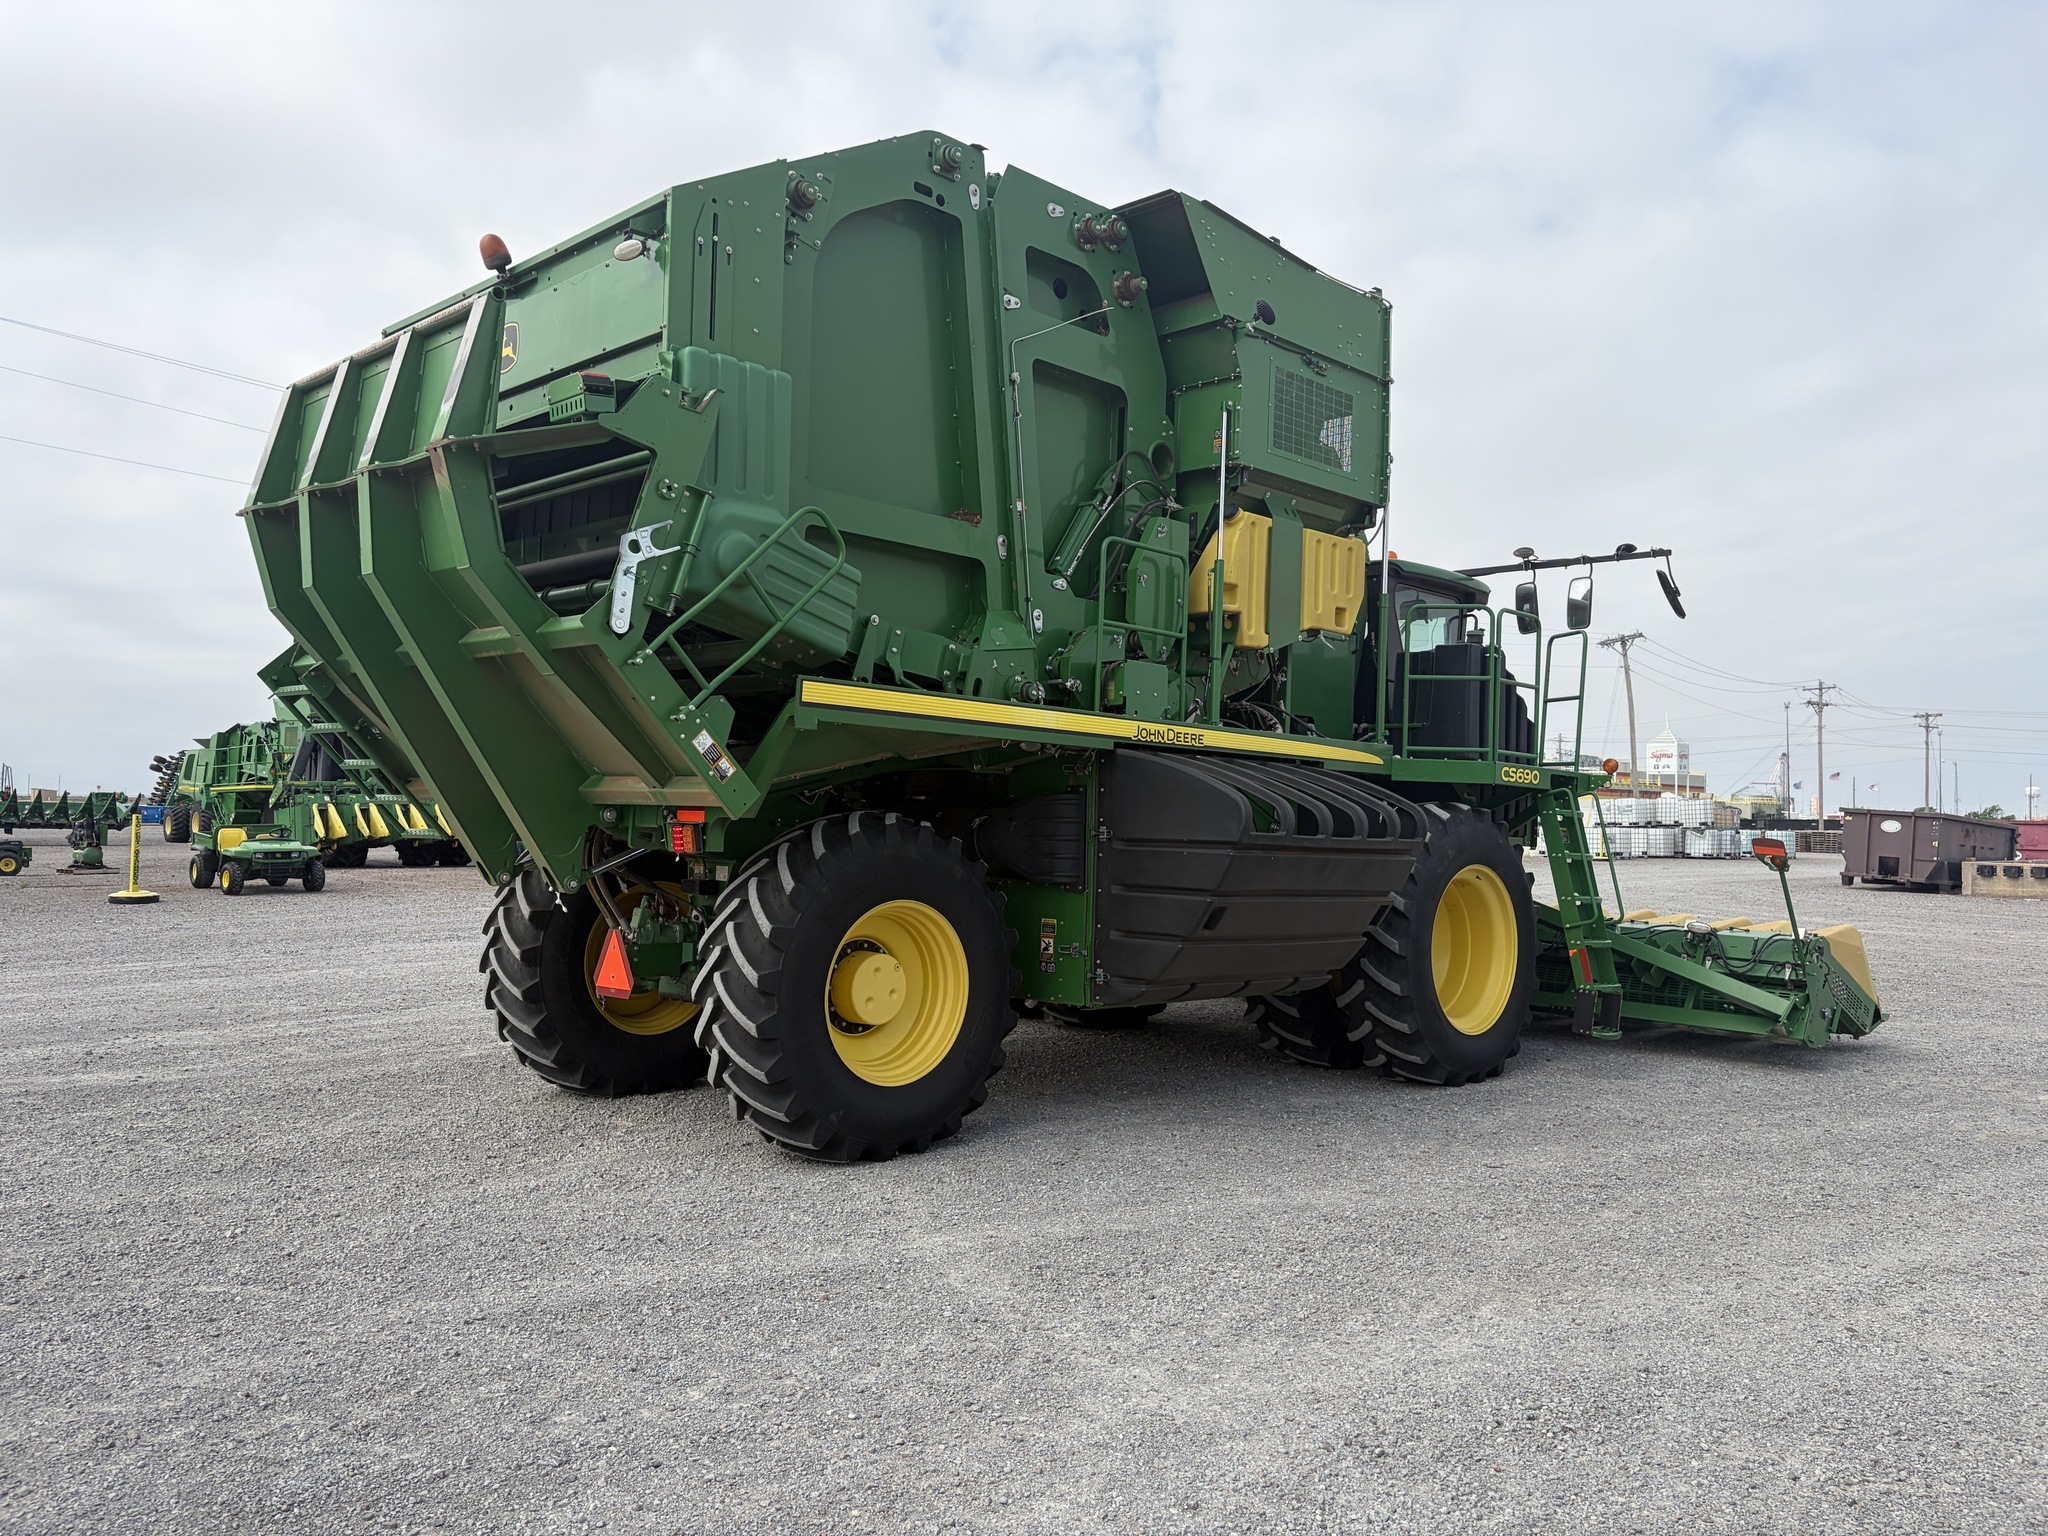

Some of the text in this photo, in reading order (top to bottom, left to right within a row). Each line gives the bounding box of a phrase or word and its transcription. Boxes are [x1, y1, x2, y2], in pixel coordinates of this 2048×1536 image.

[1132, 725, 1205, 745] JOHN DEERE
[1650, 751, 1674, 762] Sigma
[1501, 766, 1540, 785] CS690
